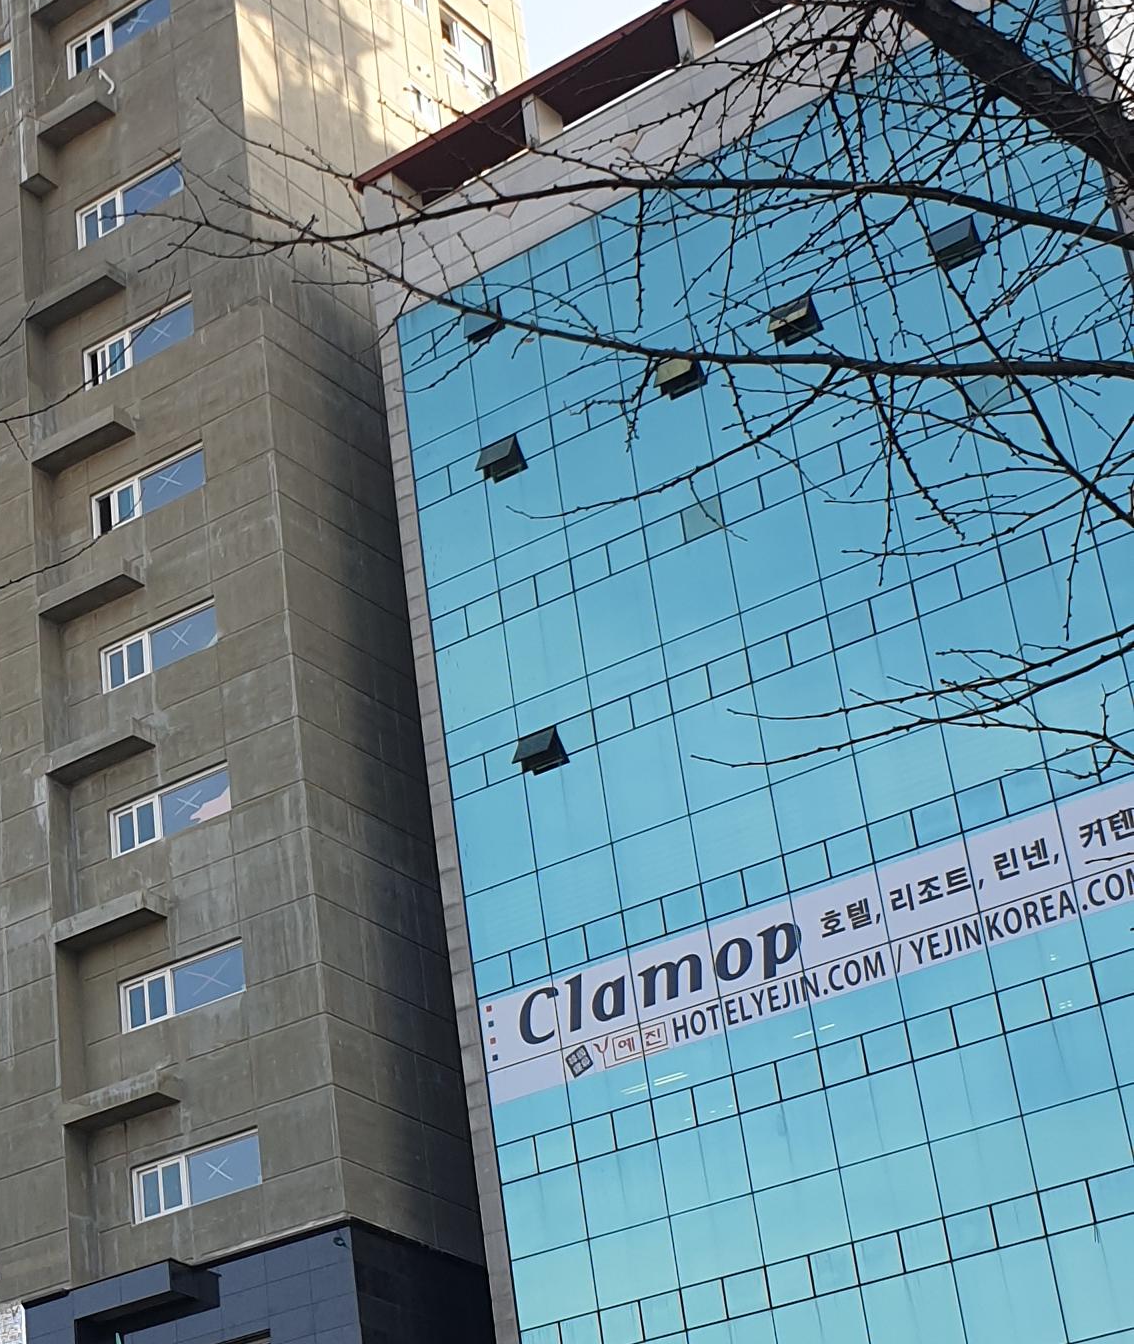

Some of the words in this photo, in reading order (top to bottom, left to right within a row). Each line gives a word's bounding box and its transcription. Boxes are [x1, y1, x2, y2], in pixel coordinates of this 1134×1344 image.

[820, 898, 882, 939] 호텔,
[889, 866, 985, 912] 리조트,
[993, 837, 1060, 882] 린넨,
[519, 918, 802, 1045] Clamop
[672, 952, 887, 1043] HOTELYEJIN.COM
